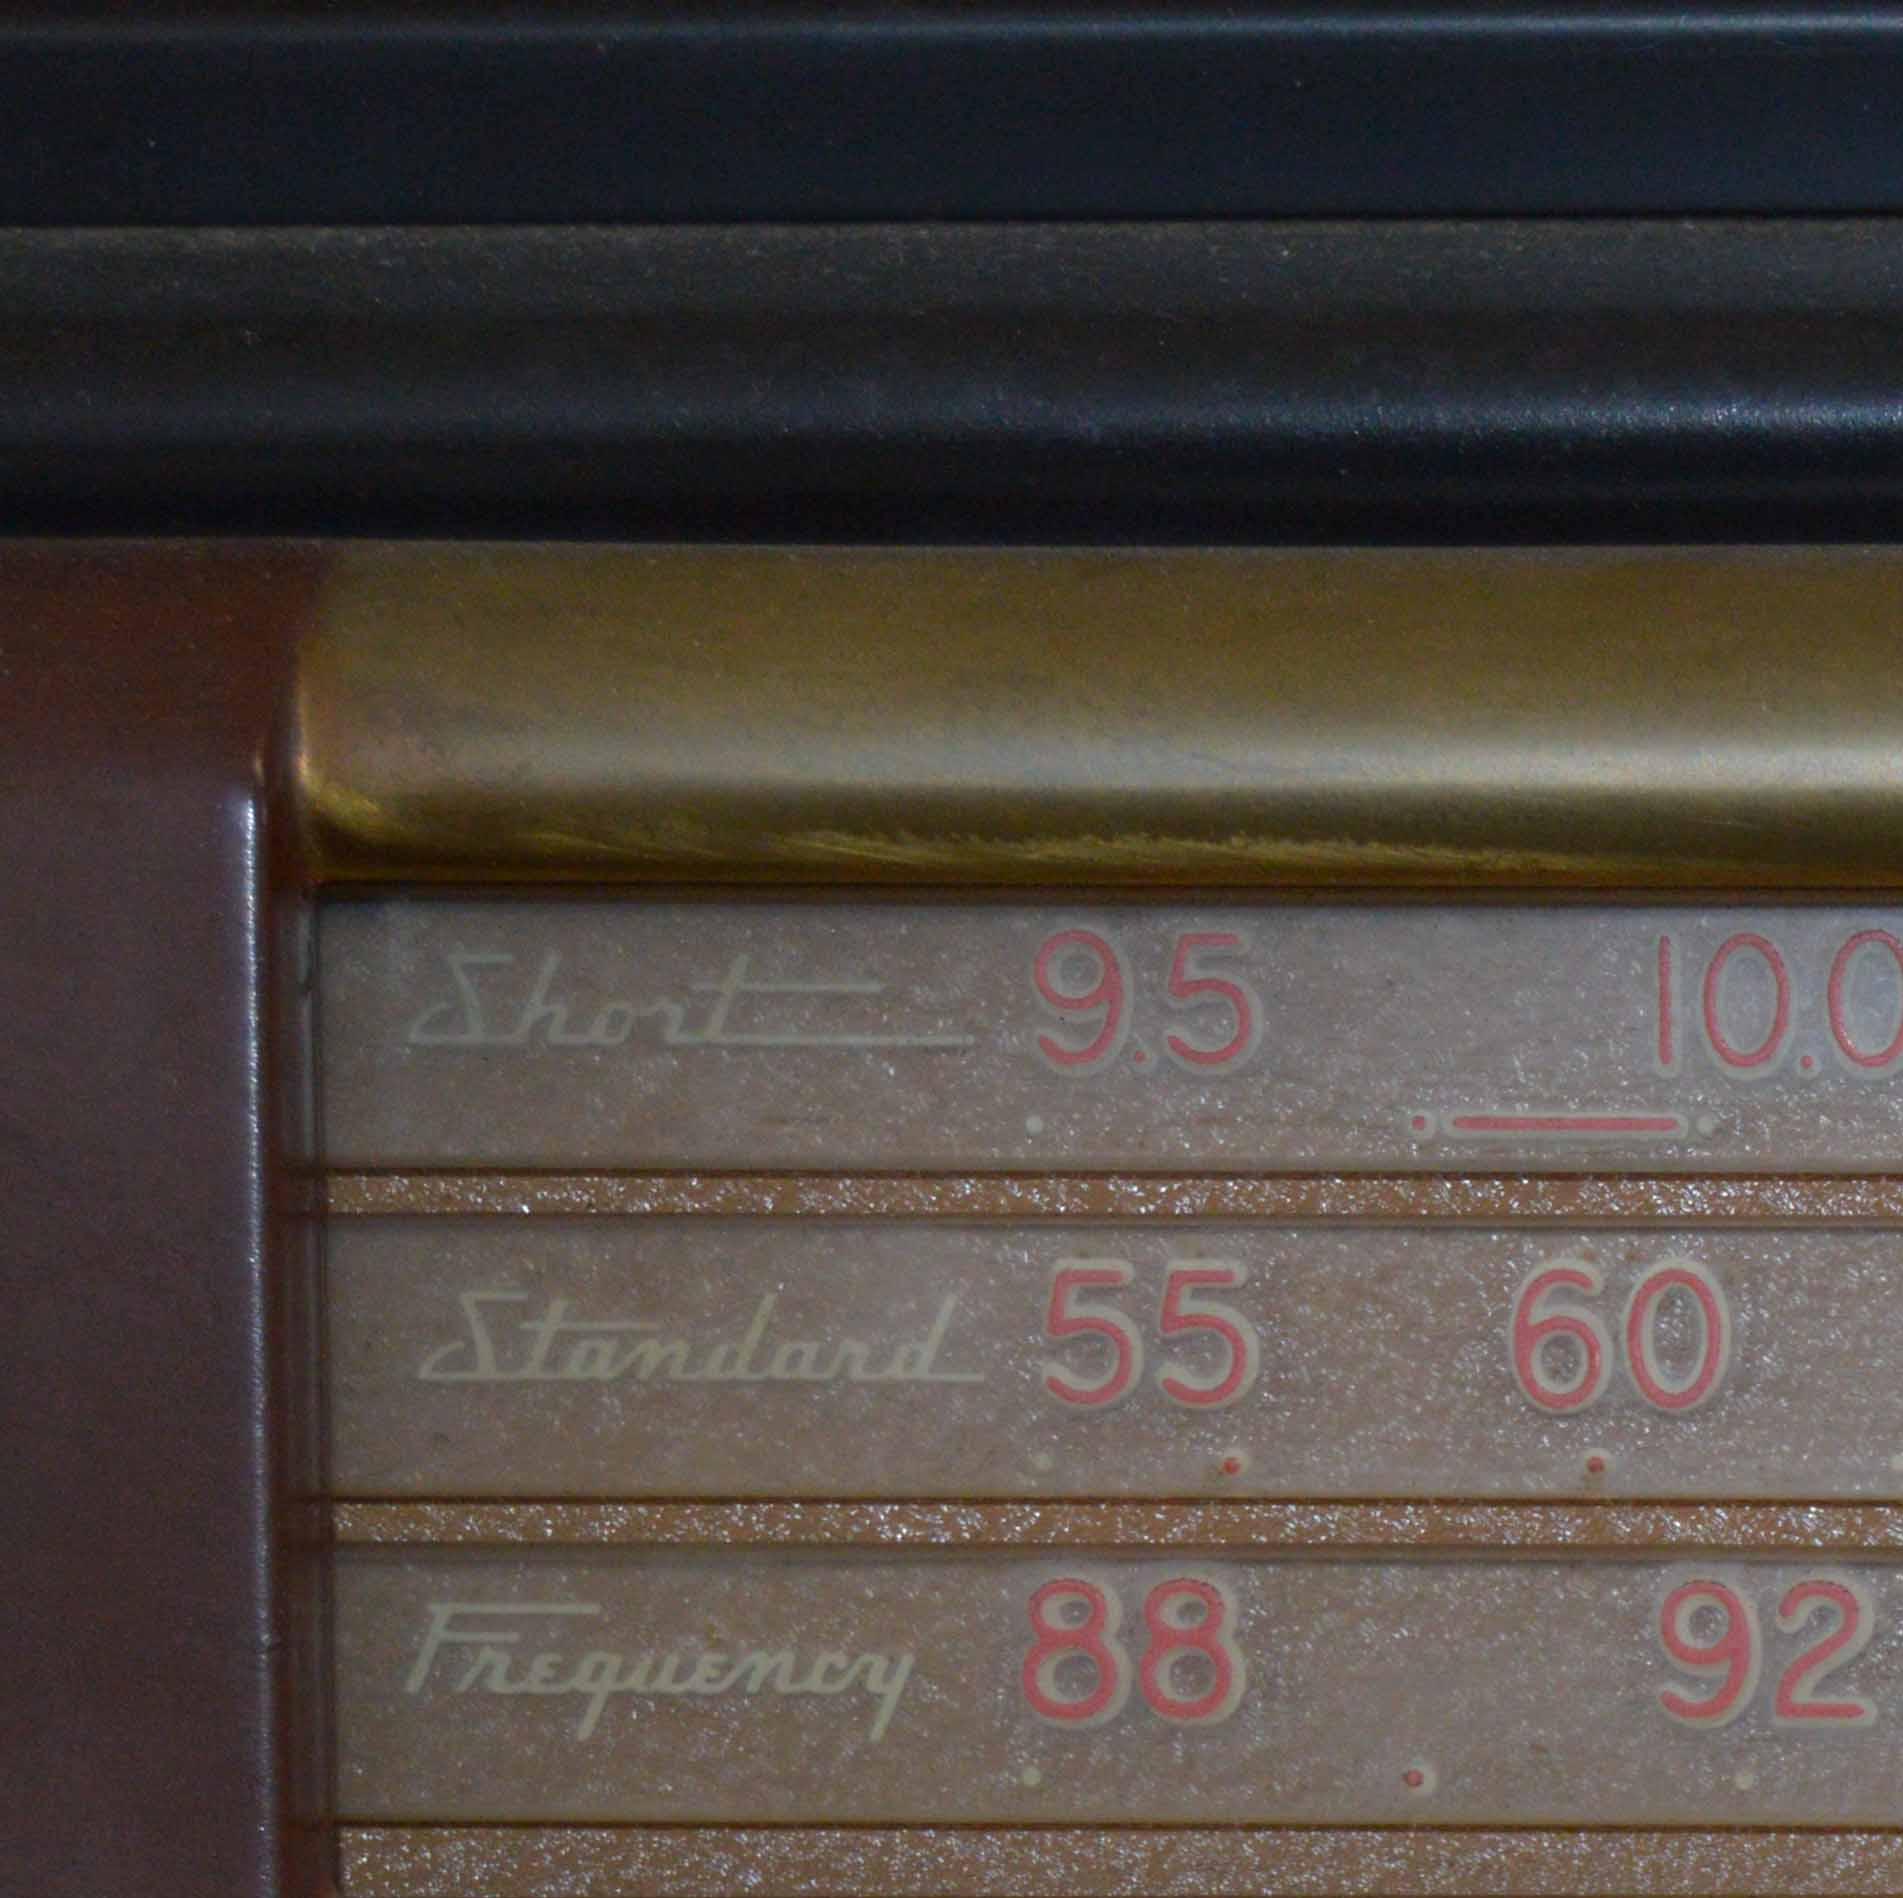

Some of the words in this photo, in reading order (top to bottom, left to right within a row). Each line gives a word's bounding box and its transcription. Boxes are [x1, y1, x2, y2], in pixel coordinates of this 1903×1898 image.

[407, 952, 976, 1049] Short
[1031, 927, 1255, 1069] 9.5
[418, 1290, 986, 1385] Standard
[1043, 1266, 1250, 1409] 55
[1510, 1265, 1725, 1413] 60
[406, 1602, 915, 1741] Frequency
[1017, 1575, 1236, 1724] 88
[1656, 1577, 1868, 1722] 92
